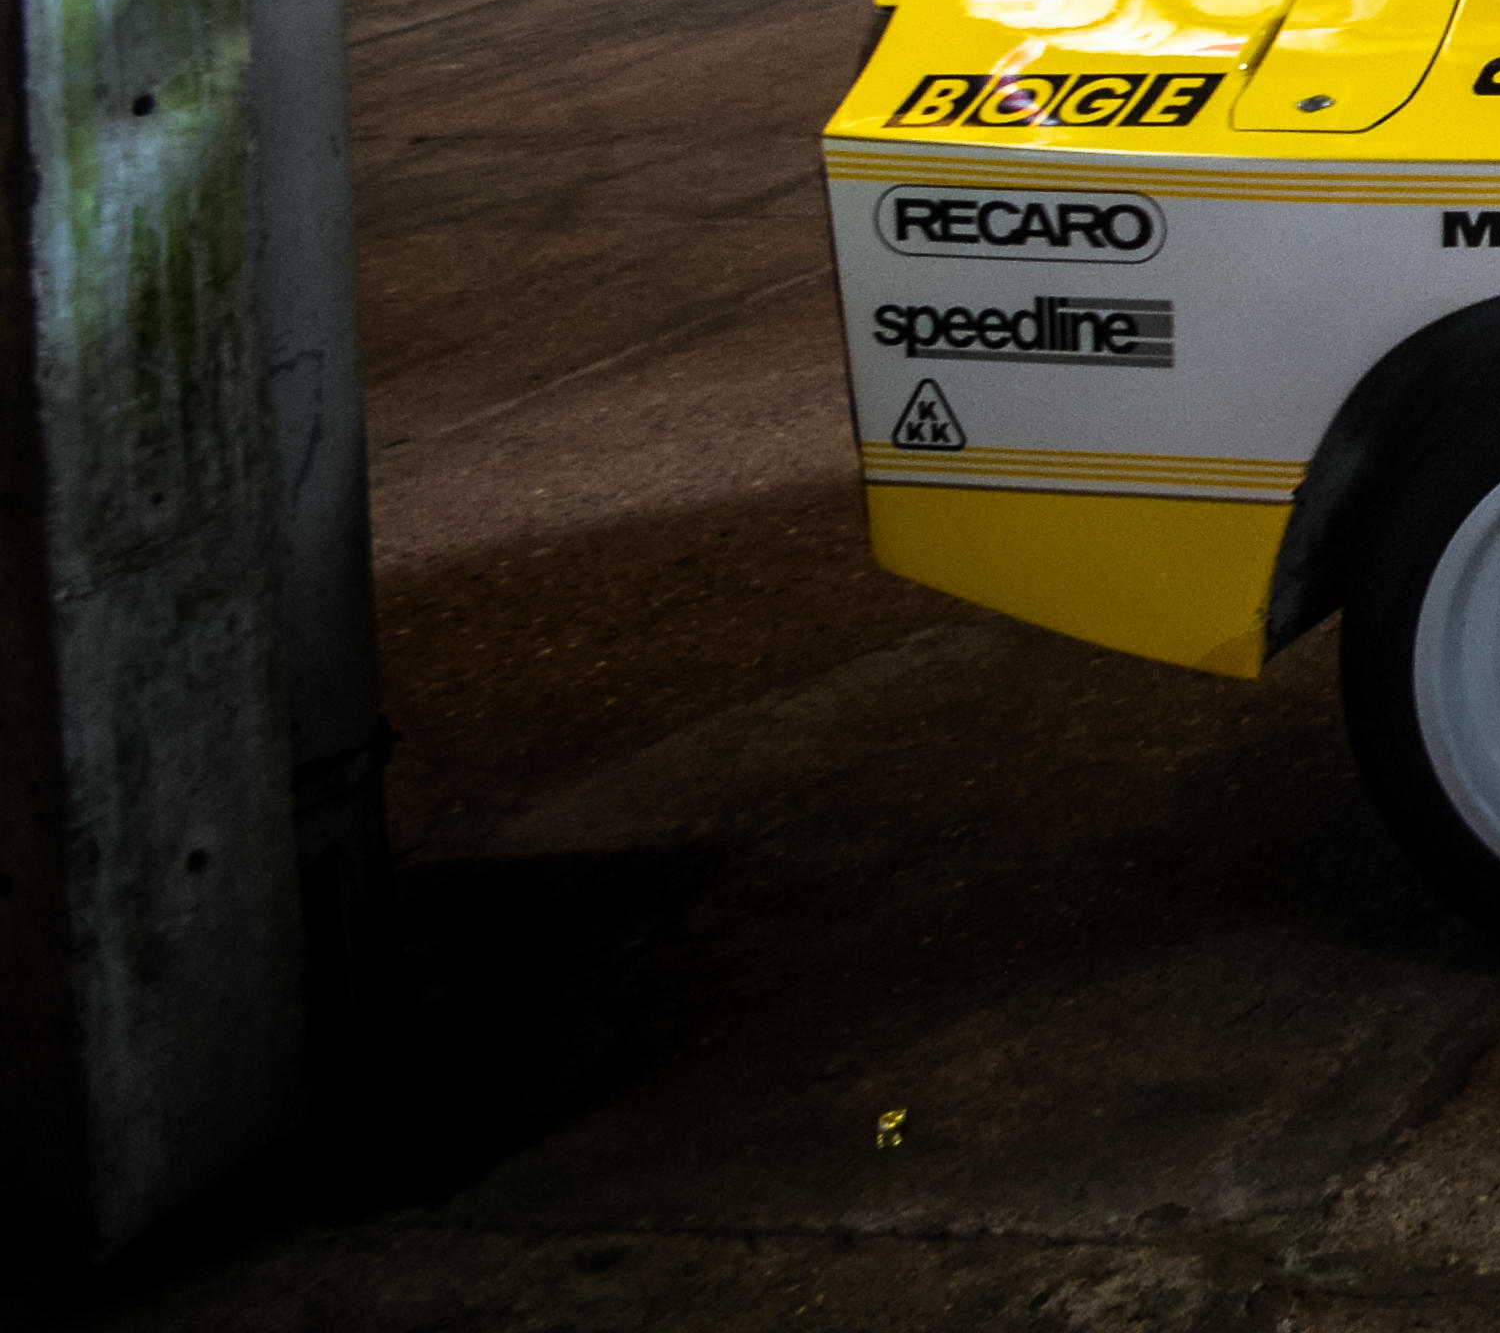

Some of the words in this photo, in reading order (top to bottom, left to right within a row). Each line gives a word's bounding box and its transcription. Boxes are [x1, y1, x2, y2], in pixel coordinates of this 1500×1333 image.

[898, 76, 1207, 125] BOGE
[895, 197, 1152, 250] RECARO
[873, 295, 1138, 358] speedline
[918, 400, 938, 419] K
